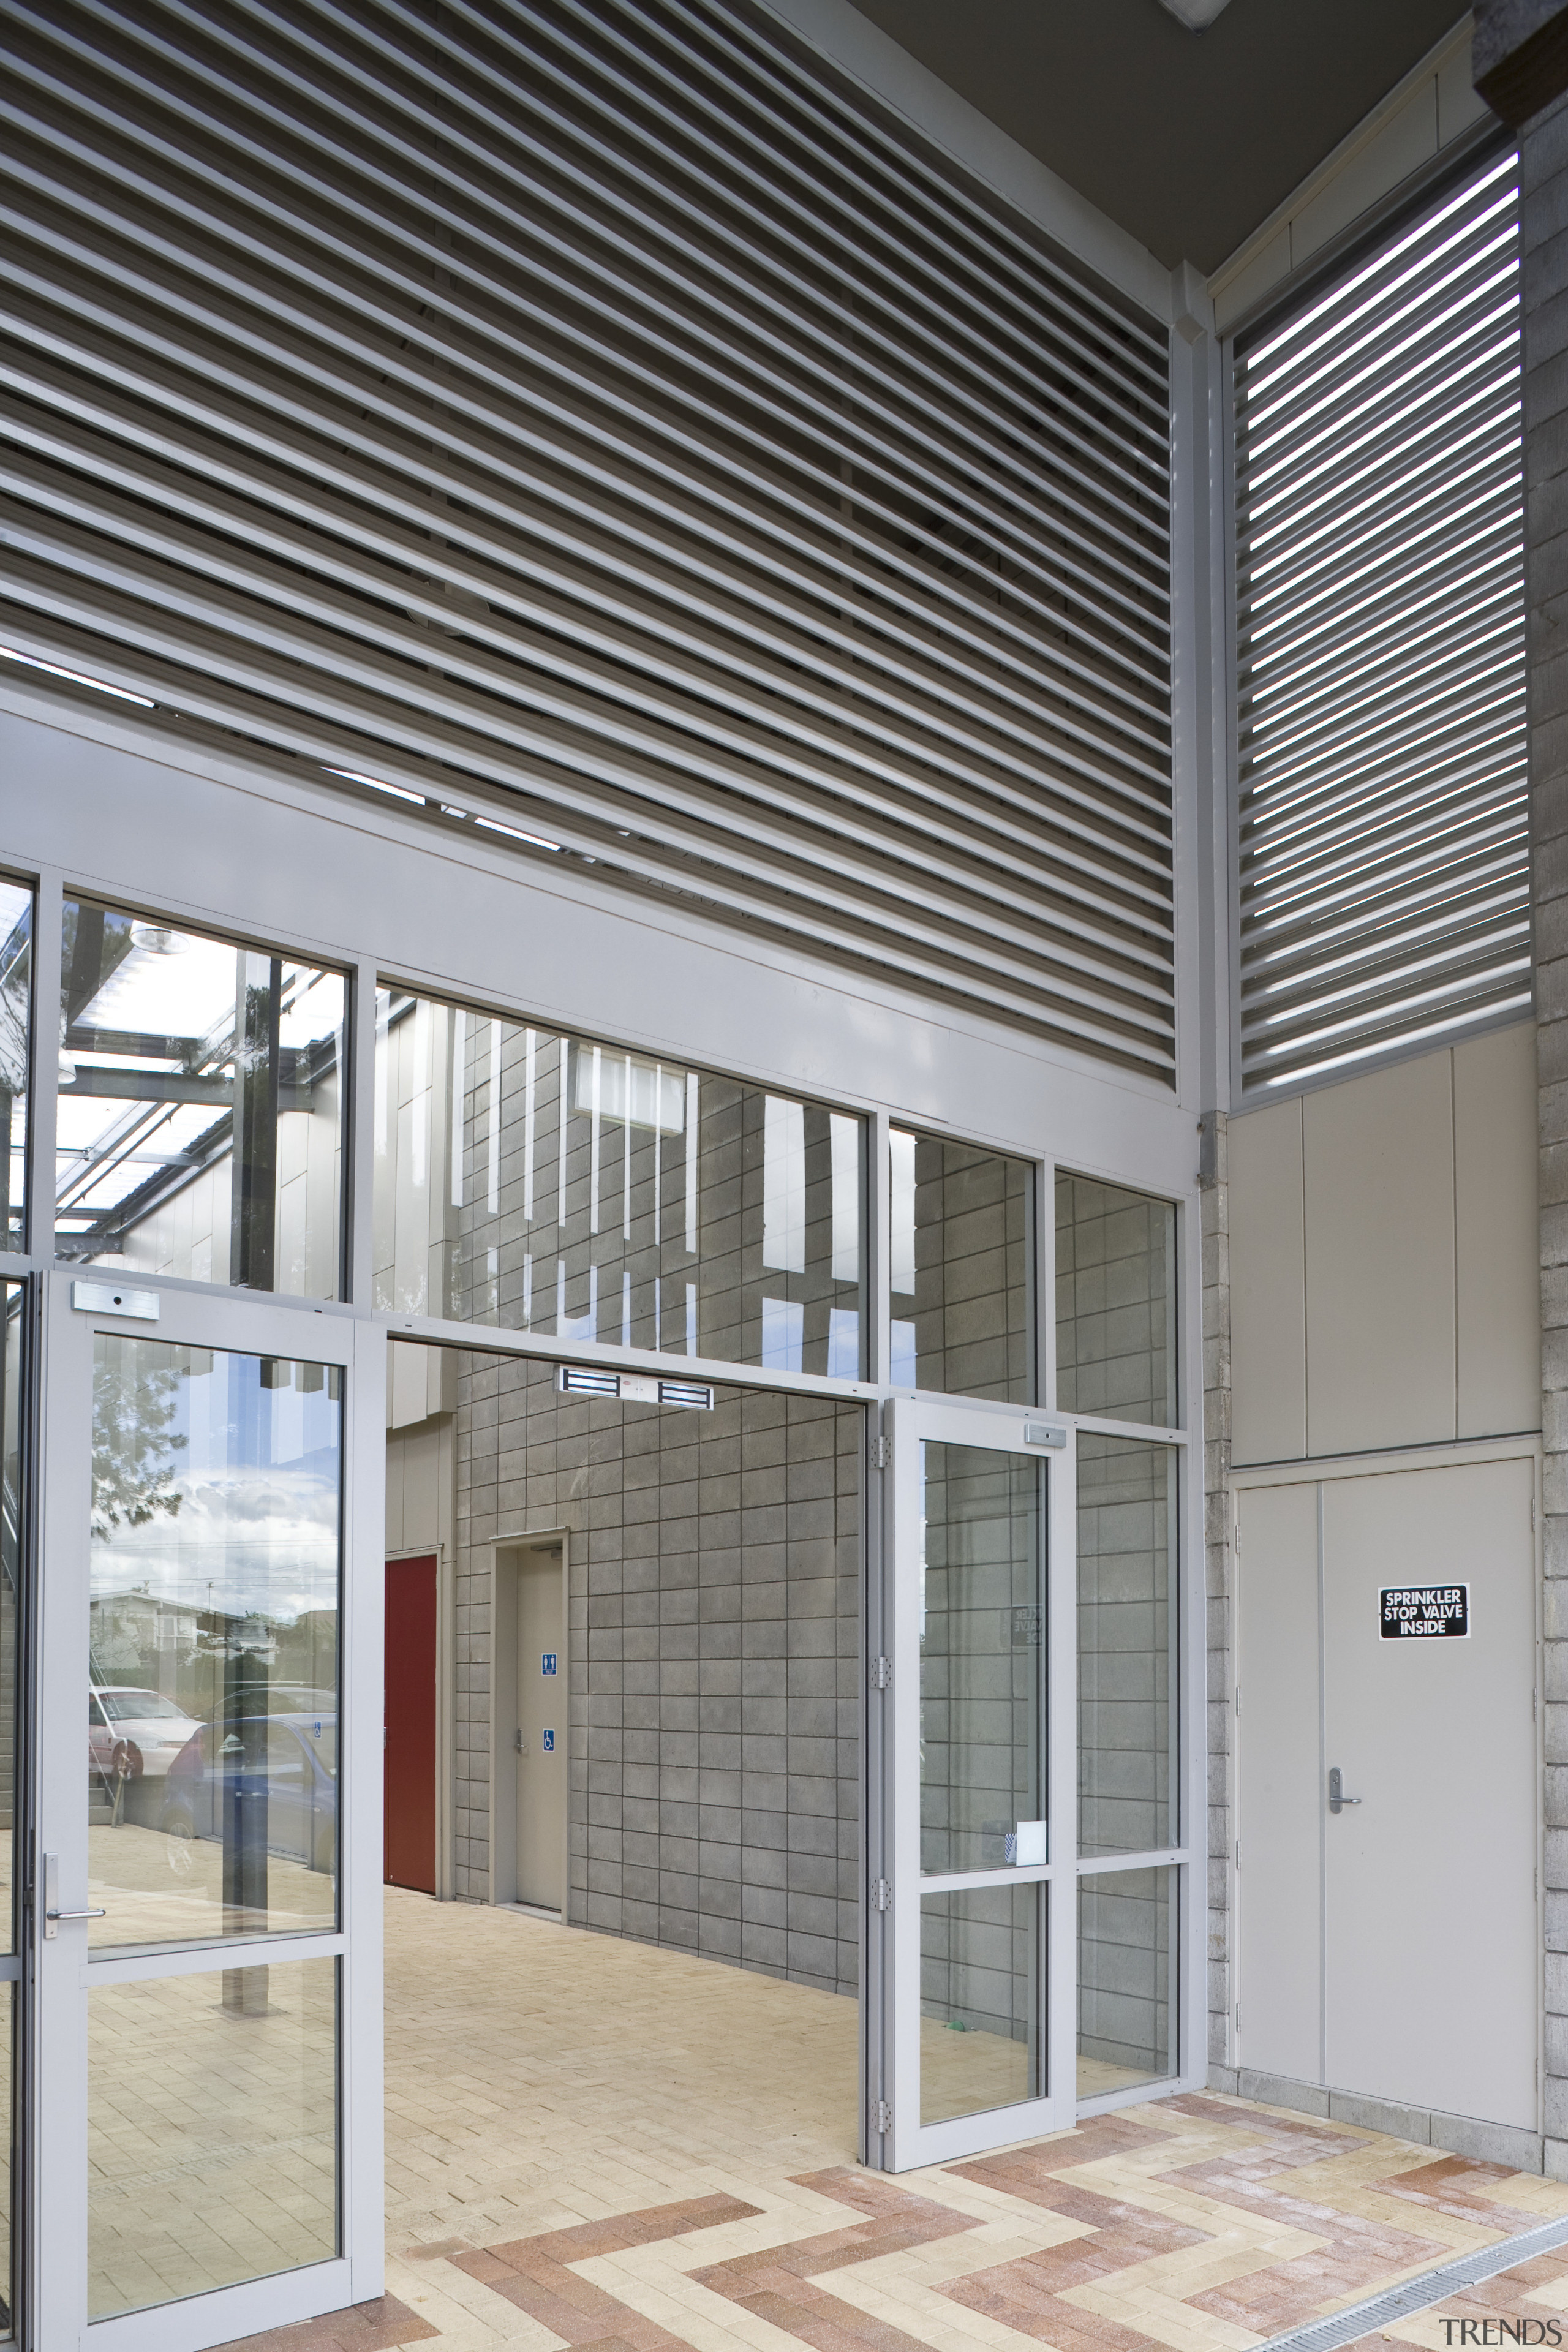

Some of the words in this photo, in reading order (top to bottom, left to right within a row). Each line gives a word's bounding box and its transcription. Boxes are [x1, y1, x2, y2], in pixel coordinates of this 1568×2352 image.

[1386, 1589, 1461, 1606] SPRINKLER
[1384, 1606, 1417, 1621] STOP
[1422, 1604, 1463, 1619] VALVE
[1400, 1620, 1446, 1634] INSIDE
